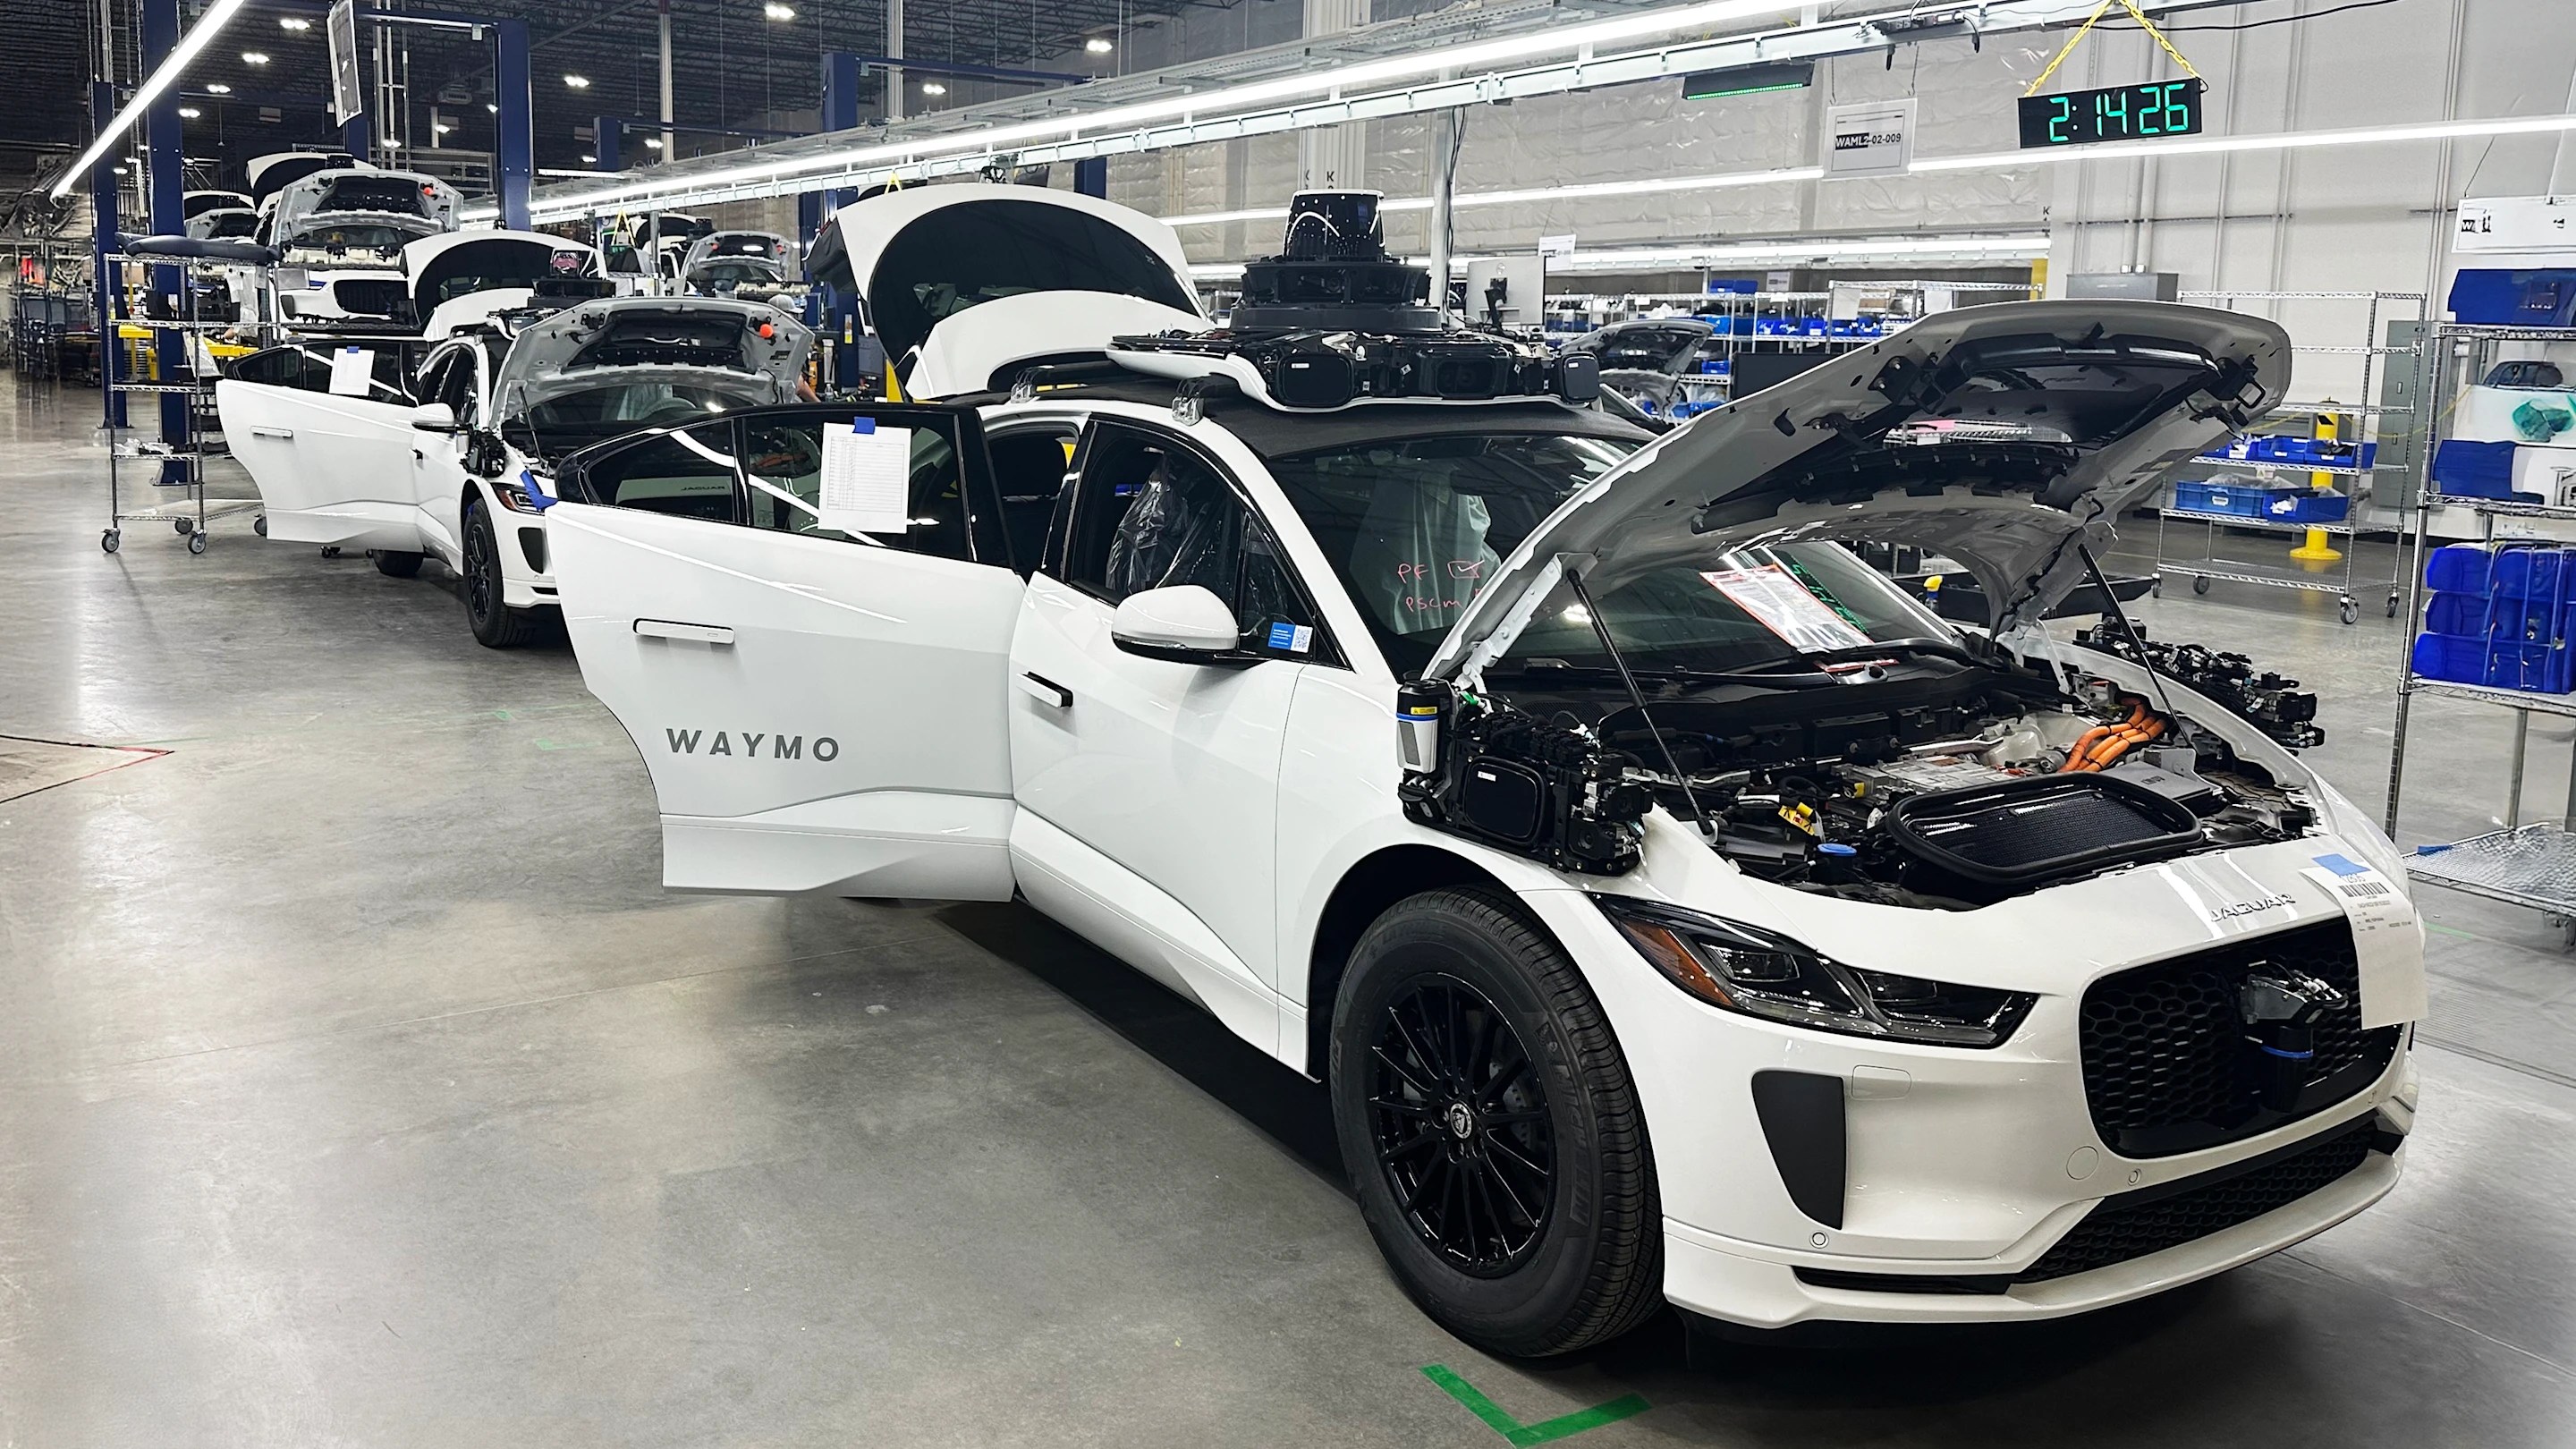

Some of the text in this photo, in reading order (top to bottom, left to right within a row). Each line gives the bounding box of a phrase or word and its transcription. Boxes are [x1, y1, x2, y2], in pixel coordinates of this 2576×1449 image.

[2139, 82, 2189, 135] 26
[665, 728, 839, 762] WAYMO
[2211, 894, 2296, 922] JAGUAR
